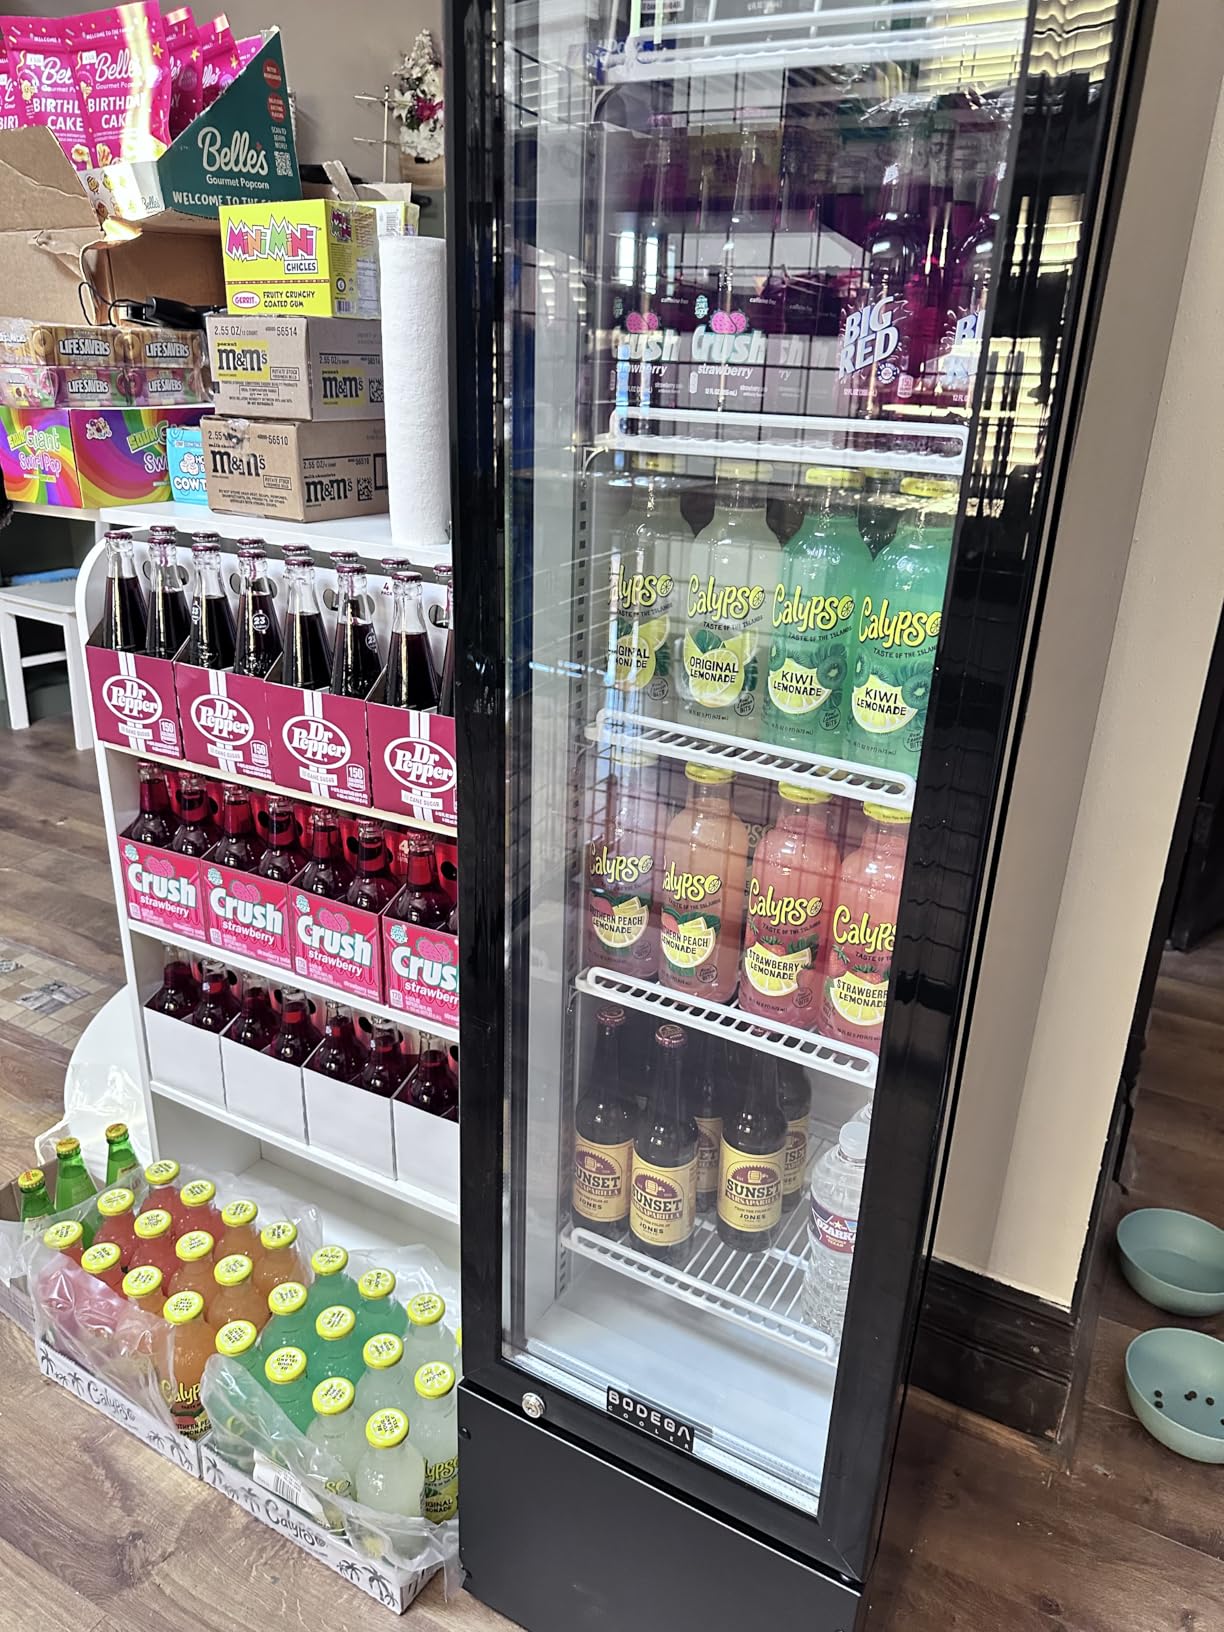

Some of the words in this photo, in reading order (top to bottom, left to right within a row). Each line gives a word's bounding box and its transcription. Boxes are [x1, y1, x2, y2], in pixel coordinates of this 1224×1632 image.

[48, 116, 84, 131] CAKE
[102, 113, 126, 129] CAK
[198, 126, 268, 177] Belle's
[206, 174, 240, 186] Gourmet
[240, 178, 270, 190] Popcorn
[172, 190, 222, 206] WELCOME
[286, 262, 316, 272] CHICLES
[235, 296, 255, 304] GERRIT
[263, 291, 284, 299] FRUITY
[264, 300, 288, 308] COATED
[214, 326, 229, 336] 2.55
[844, 296, 894, 347] BIG
[956, 310, 985, 345] BI
[692, 324, 766, 364] Crush
[839, 326, 898, 380] RED
[698, 364, 754, 380] strawberry
[24, 425, 60, 451] Giant
[208, 430, 222, 440] 2.55
[42, 452, 62, 478] Pop
[688, 574, 765, 620] Calypso
[772, 584, 855, 632] Calypso
[254, 616, 266, 625] 23
[703, 621, 723, 630] TASTE
[859, 597, 942, 648] Calypso
[788, 633, 808, 642] TASTE
[830, 627, 852, 640] ISLANDS
[874, 648, 894, 658] TASTE
[690, 656, 739, 674] ORIGINAL
[690, 670, 736, 684] LEMONADE
[781, 670, 814, 686] KIWI
[124, 680, 146, 700] Dr
[774, 680, 822, 697] LEMONADE
[865, 688, 898, 704] KIWI
[110, 686, 158, 718] Pepper
[214, 700, 237, 720] Dr
[856, 698, 906, 716] LEMONADE
[200, 706, 249, 739] Pepper
[308, 720, 333, 743] Dr
[826, 720, 837, 728] BITS
[292, 727, 346, 762] Pepper
[414, 742, 439, 766] Dr
[394, 749, 453, 786] Pepper
[128, 863, 196, 908] Crush
[663, 861, 722, 902] alypso
[140, 895, 189, 918] strawberry
[210, 888, 283, 935] Crush
[749, 878, 822, 926] Calypso
[592, 918, 632, 934] LEMONADE
[618, 916, 643, 926] PEACH
[763, 924, 781, 934] TASTE
[222, 920, 274, 945] strawberry
[298, 915, 372, 968] Crush
[682, 936, 708, 948] PEACH
[308, 950, 362, 976] strawberry
[750, 950, 800, 972] STRAWBERRY
[856, 952, 876, 962] TASTE
[392, 946, 459, 993] Crus
[750, 962, 794, 980] LEMONADE
[576, 1166, 620, 1188] UNSET
[726, 1179, 781, 1199] SUNSET
[580, 1198, 602, 1210] JONES
[640, 1222, 664, 1234] JONES
[608, 1390, 690, 1441] BODEGA
[608, 1406, 690, 1450] COOLER
[265, 1499, 326, 1546] Calypso
